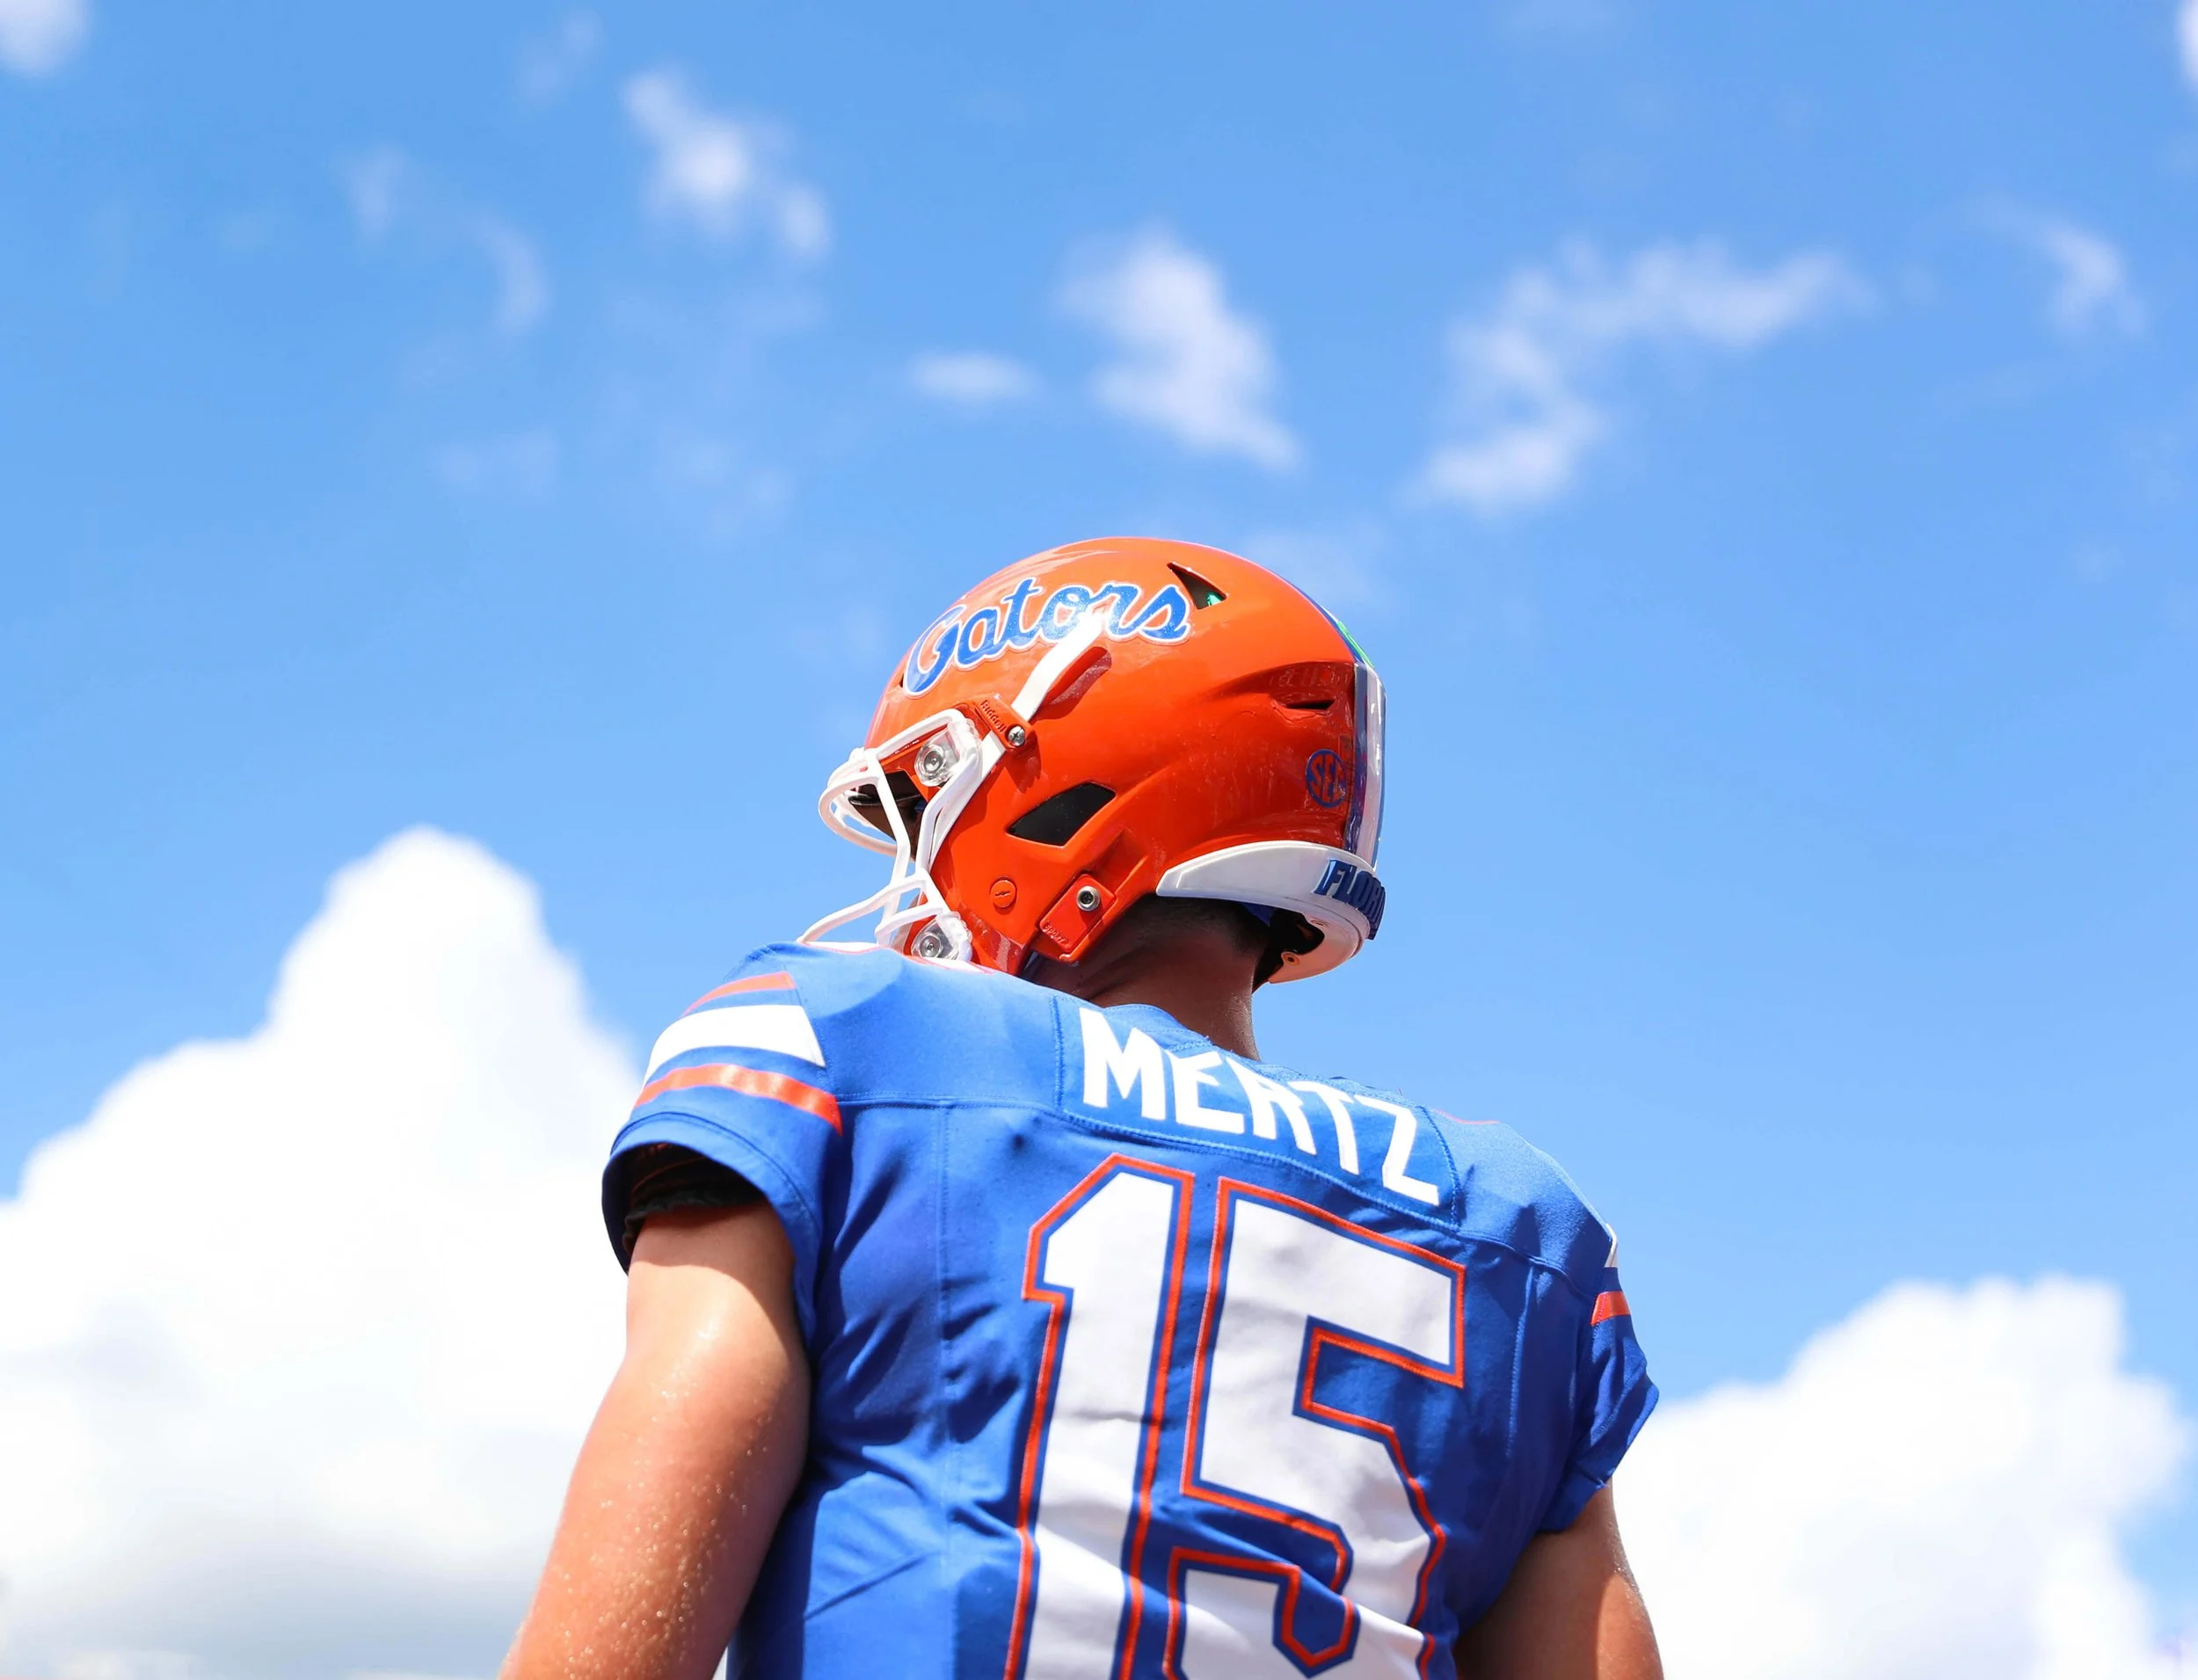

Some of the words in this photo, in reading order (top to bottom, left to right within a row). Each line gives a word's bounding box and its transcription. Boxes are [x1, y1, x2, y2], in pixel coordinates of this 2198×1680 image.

[903, 576, 1191, 696] Gators
[1079, 1007, 1439, 1206] MERTZ
[1003, 1153, 1467, 1680] 15
